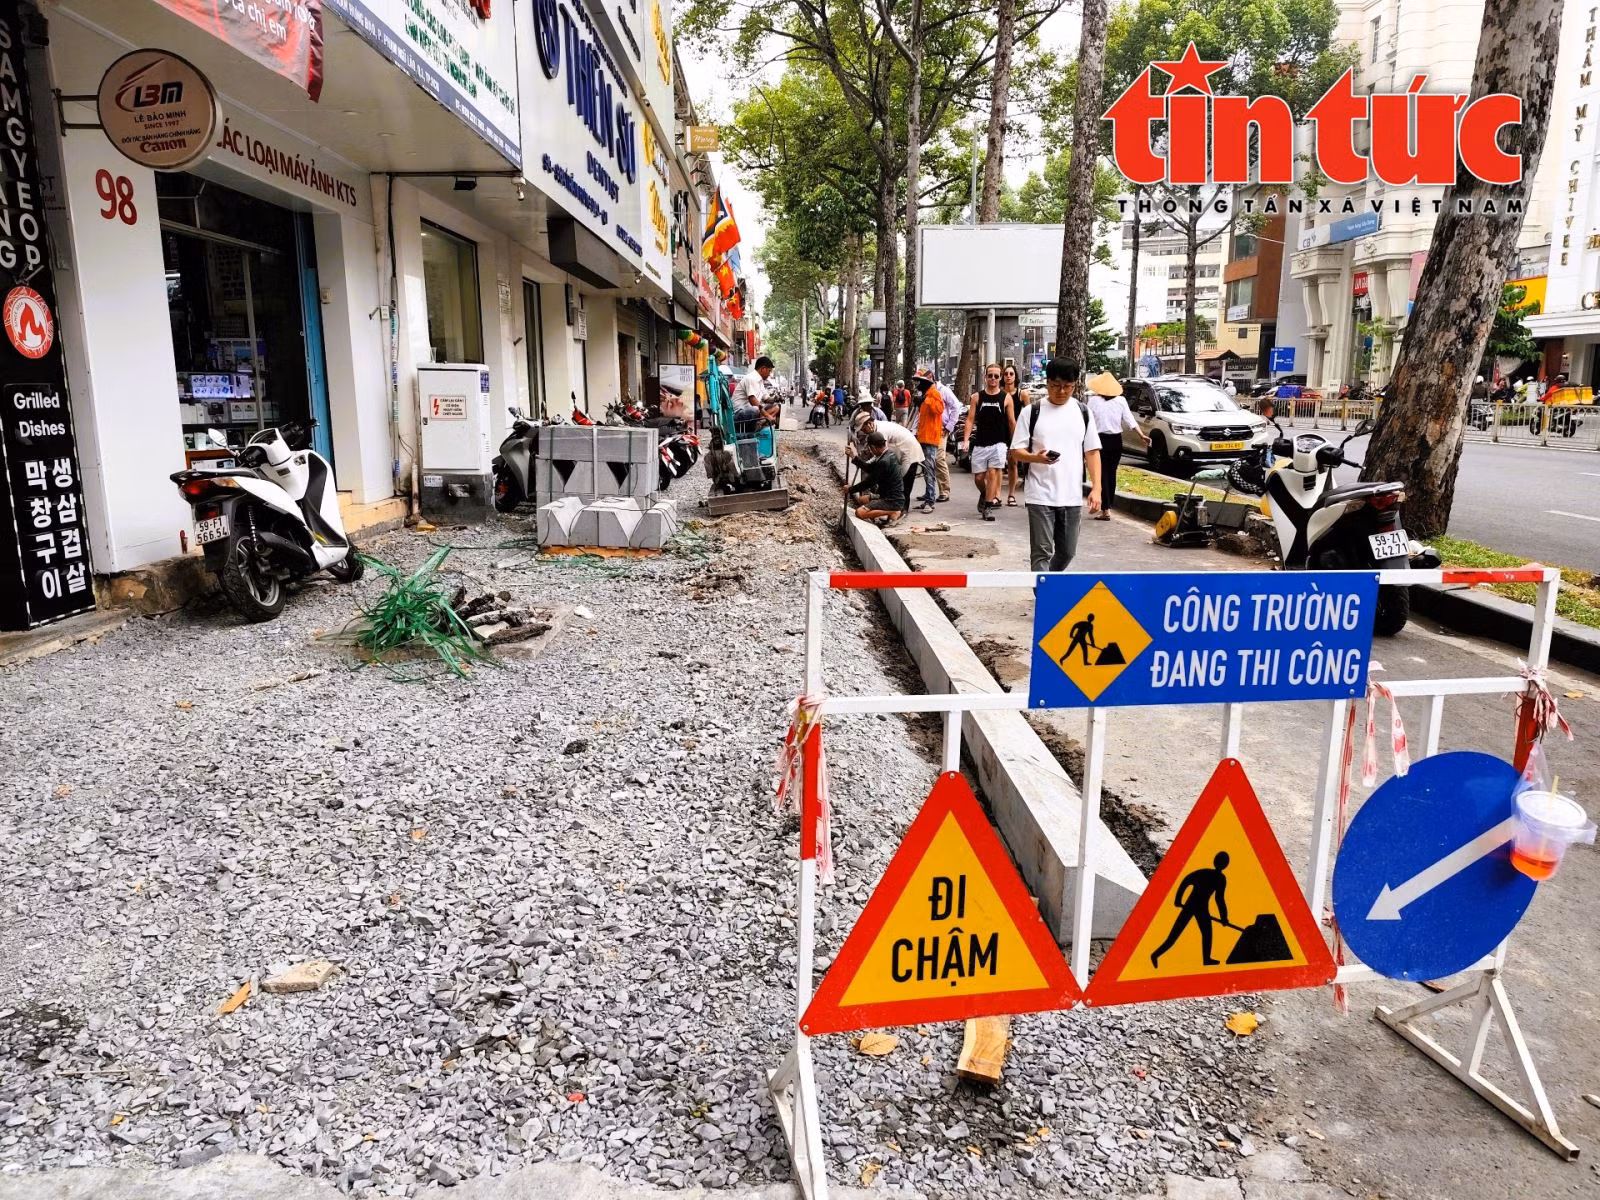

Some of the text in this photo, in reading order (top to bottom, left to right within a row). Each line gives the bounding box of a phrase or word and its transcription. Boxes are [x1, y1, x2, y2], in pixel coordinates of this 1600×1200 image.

[247, 2, 267, 33] chị
[268, 18, 287, 42] em
[144, 122, 163, 130] SINCE
[166, 110, 186, 119] MINH
[140, 138, 187, 153] Canon
[217, 117, 357, 207] ÁC LOẠI MÁY ẢNH KTS
[95, 168, 138, 226] 98
[587, 150, 620, 204] DENTIST
[1561, 160, 1580, 266] CHIVEE
[13, 391, 61, 410] Grilled
[18, 419, 66, 438] Dishes
[25, 460, 62, 599] 막창구이
[52, 457, 87, 594] 생삼겹살
[199, 517, 223, 532] 59-F1
[1375, 532, 1401, 546] 59-Z1
[1375, 543, 1408, 558] 242.71
[1162, 582, 1361, 633] CÔNG TRƯỜNG
[1150, 640, 1361, 688] ĐANG THI CÔNG
[928, 874, 967, 921] ĐI
[891, 926, 999, 987] CHẬM
